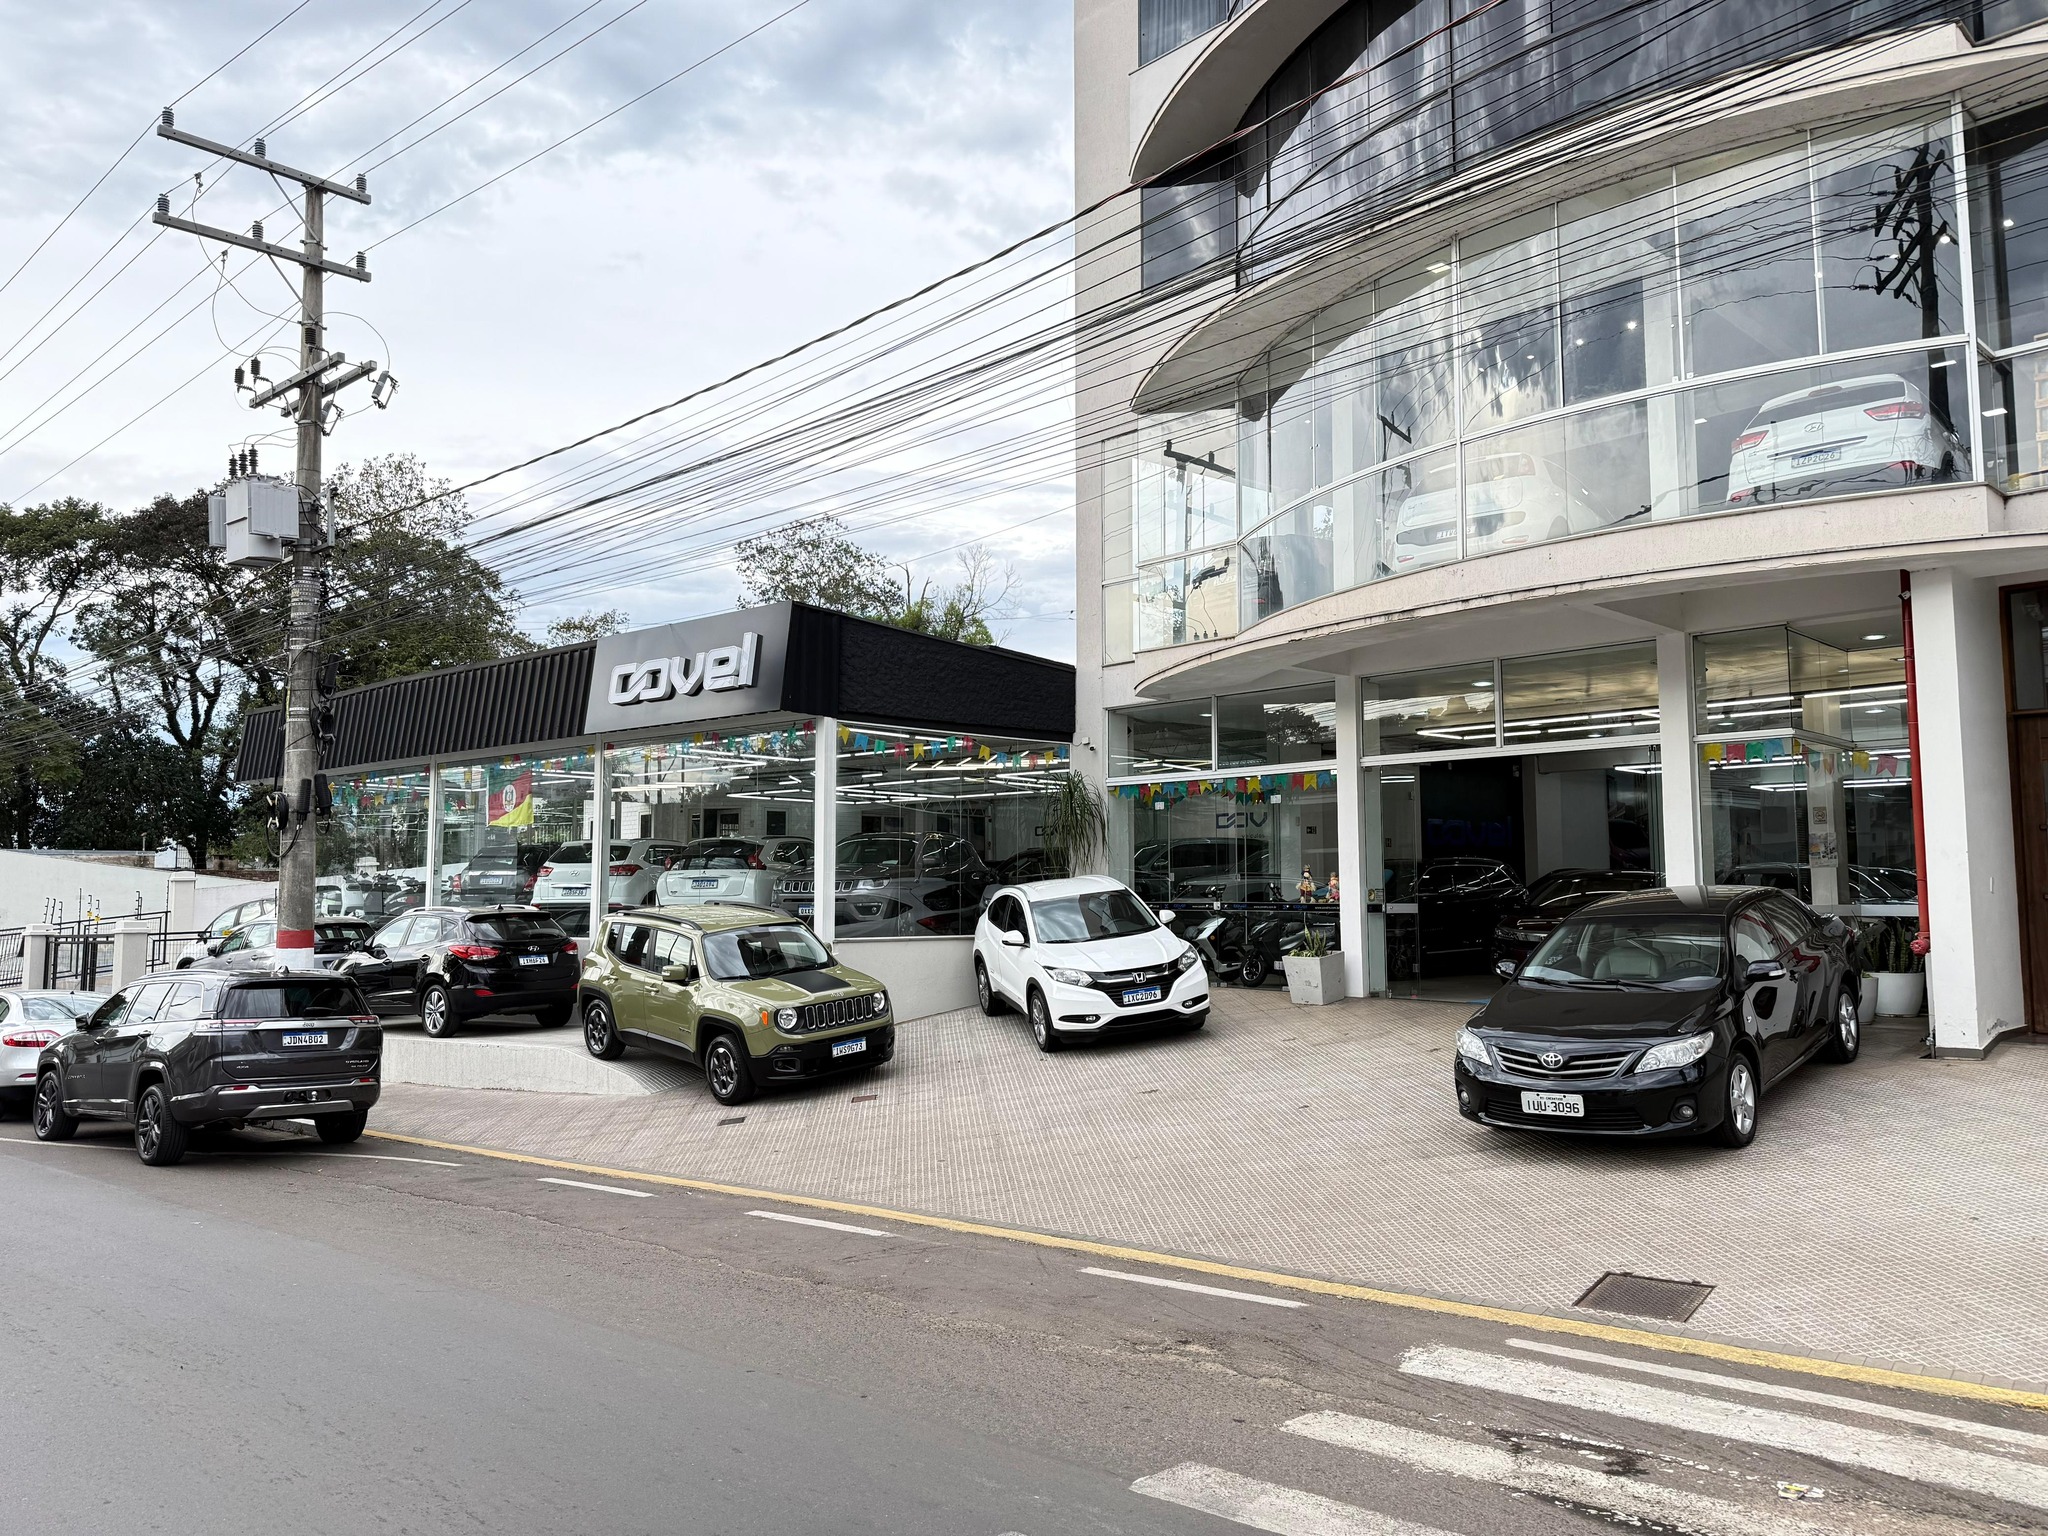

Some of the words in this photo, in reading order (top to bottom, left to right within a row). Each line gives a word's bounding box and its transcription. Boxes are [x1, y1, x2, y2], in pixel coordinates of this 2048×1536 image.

[607, 631, 759, 705] covel
[1127, 991, 1158, 1003] IXC2D96
[287, 1035, 324, 1045] JDN4B02
